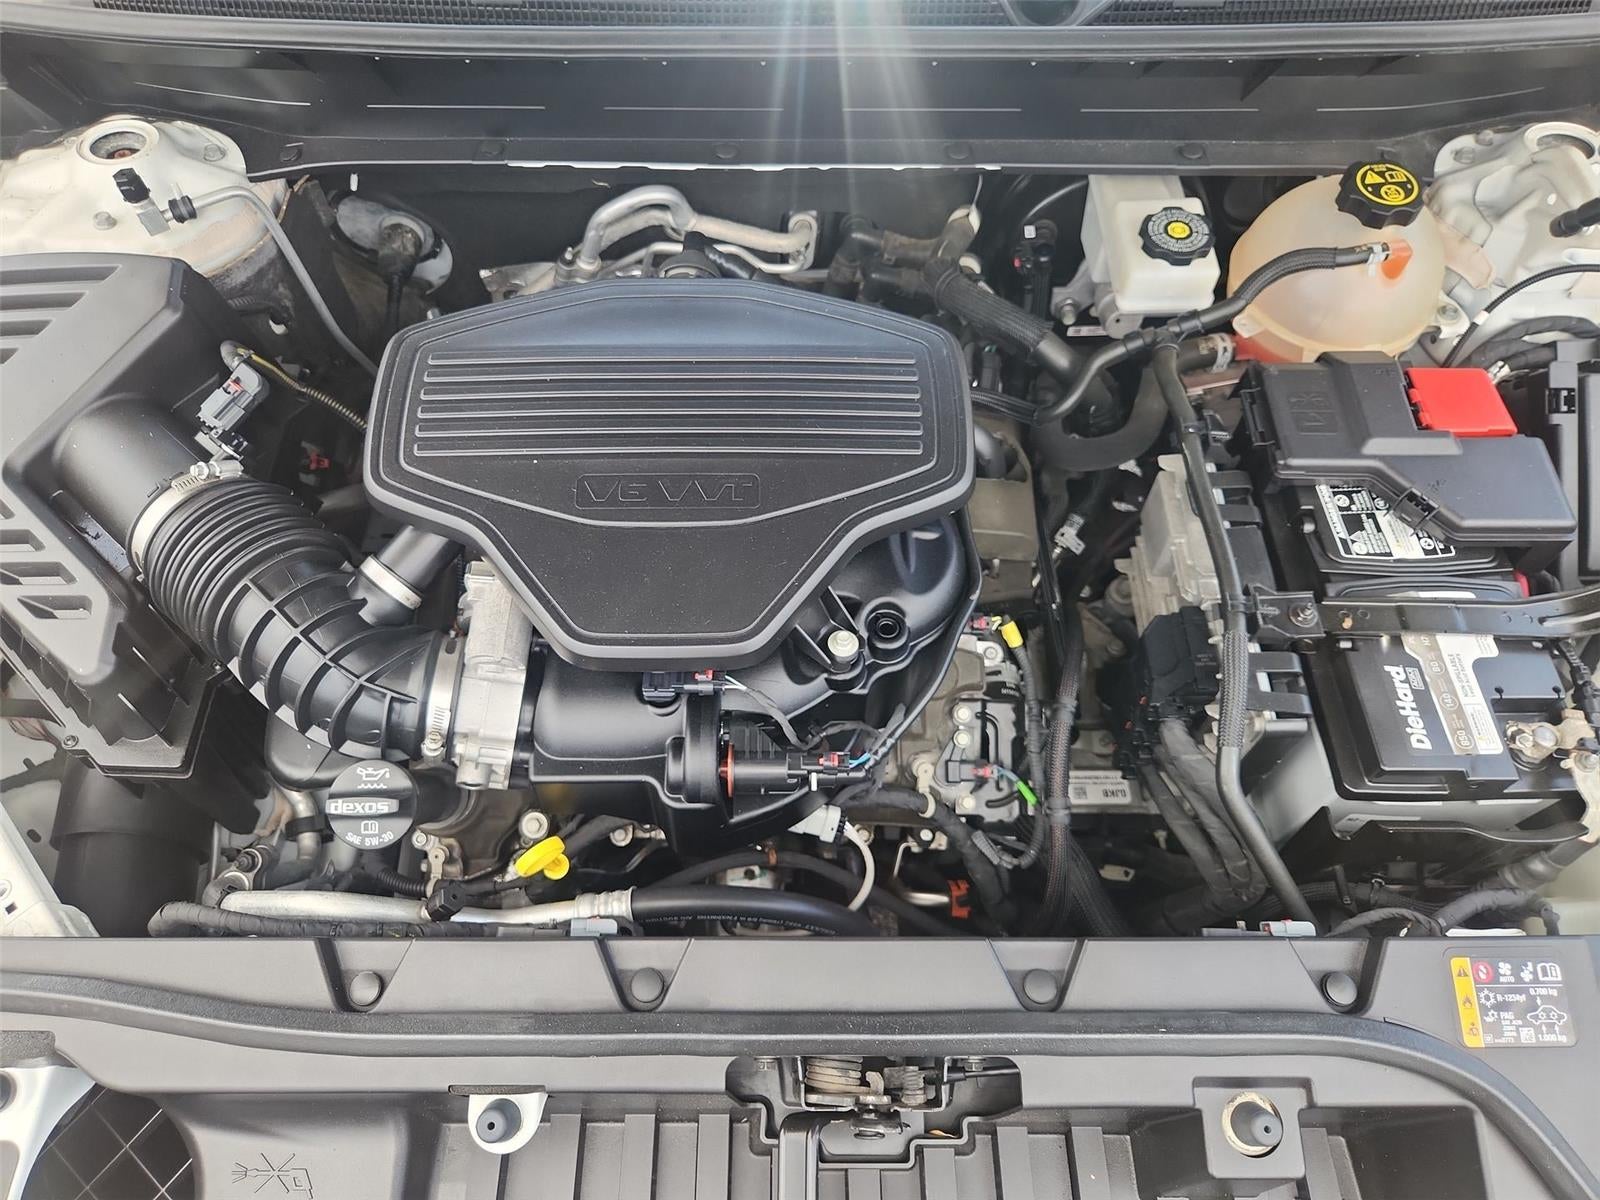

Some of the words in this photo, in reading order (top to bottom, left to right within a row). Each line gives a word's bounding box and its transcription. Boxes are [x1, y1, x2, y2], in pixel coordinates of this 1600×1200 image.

[657, 479, 754, 502] VVT
[1384, 665, 1433, 750] DieHard
[1442, 693, 1454, 707] 140
[1457, 730, 1469, 747] 850
[330, 800, 389, 814] dexos
[345, 832, 362, 845] SAE
[364, 831, 394, 846] 5W-30
[1500, 1012, 1515, 1020] PAG
